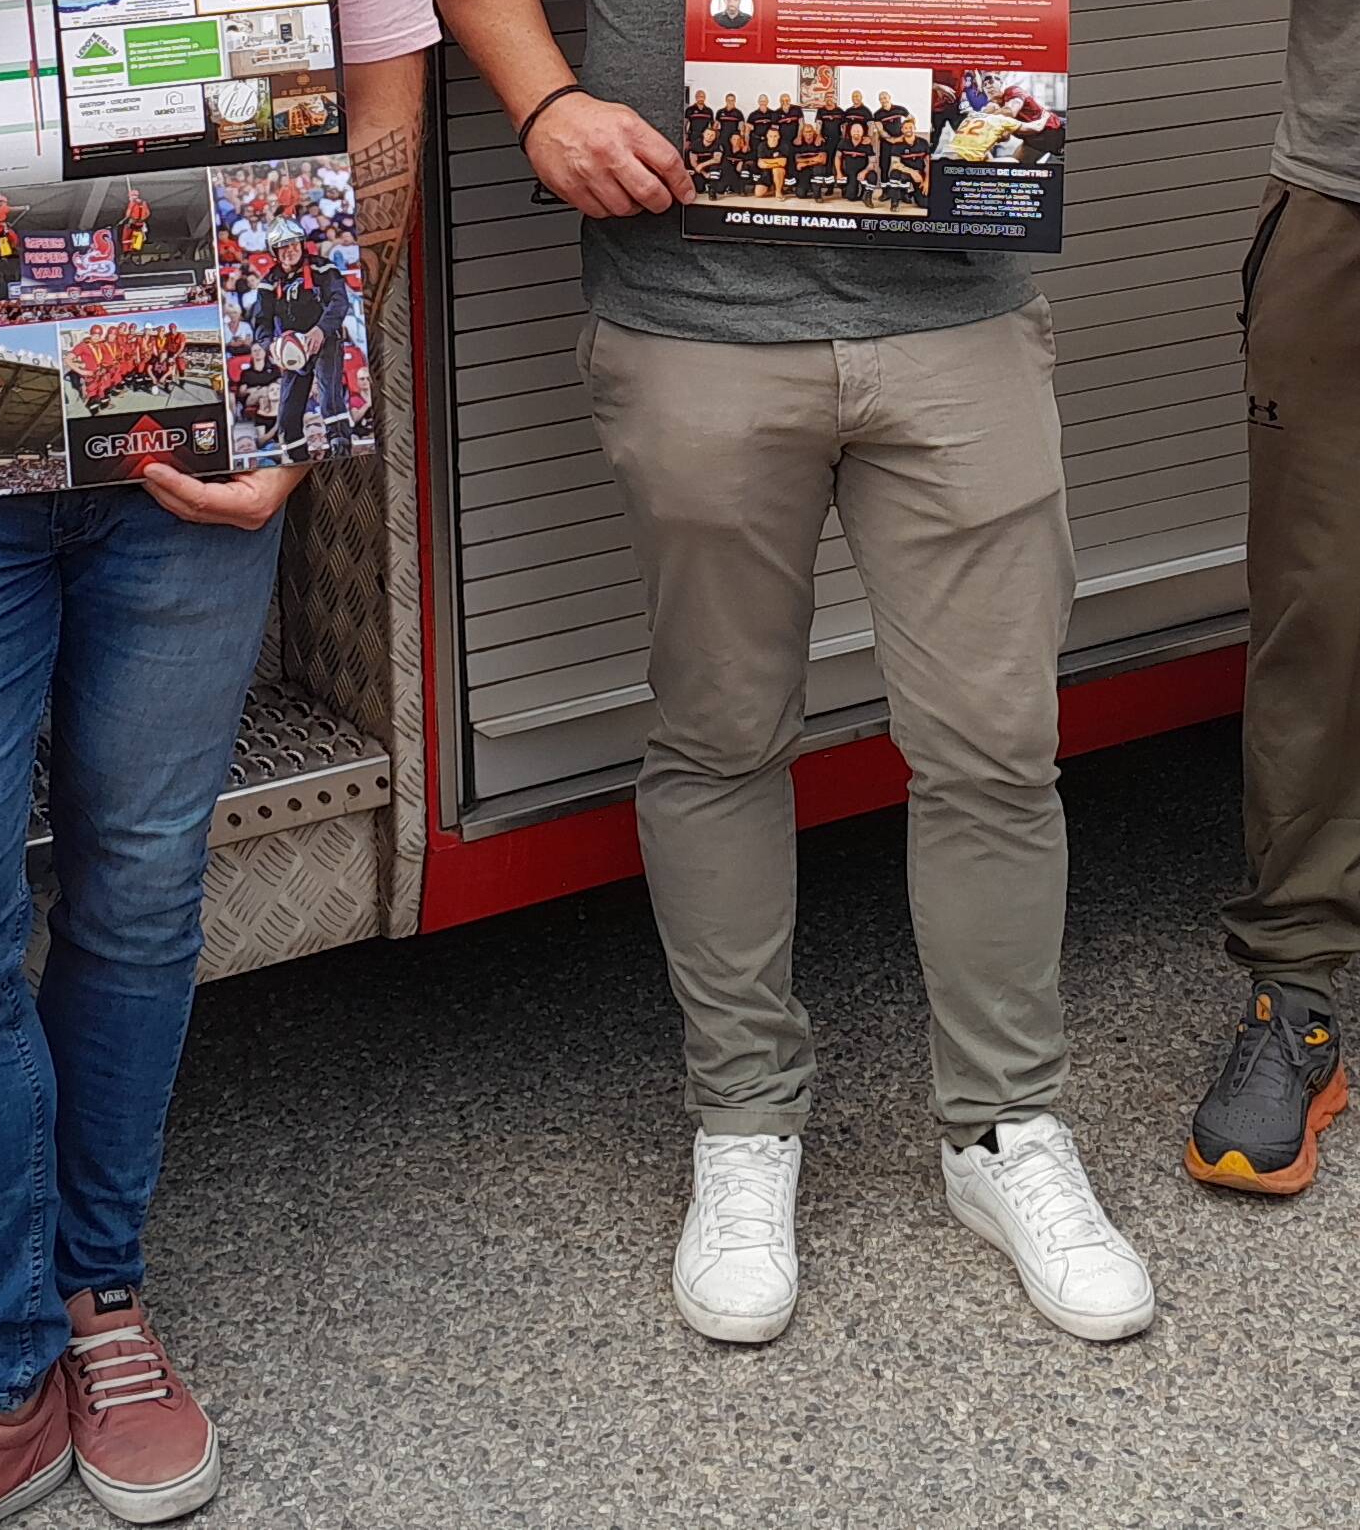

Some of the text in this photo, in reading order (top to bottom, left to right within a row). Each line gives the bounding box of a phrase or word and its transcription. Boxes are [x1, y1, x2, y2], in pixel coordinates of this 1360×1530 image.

[76, 38, 94, 59] LEROY
[91, 32, 119, 55] MERLIN
[225, 91, 256, 119] lido
[725, 211, 751, 224] JOÉ
[801, 216, 857, 229] KARABA
[860, 218, 878, 230] ET
[879, 220, 910, 232] SON
[912, 221, 959, 233] ONCLE
[961, 223, 1026, 236] POMPIER
[85, 428, 187, 458] GRIMP
[98, 1289, 130, 1305] VANS
